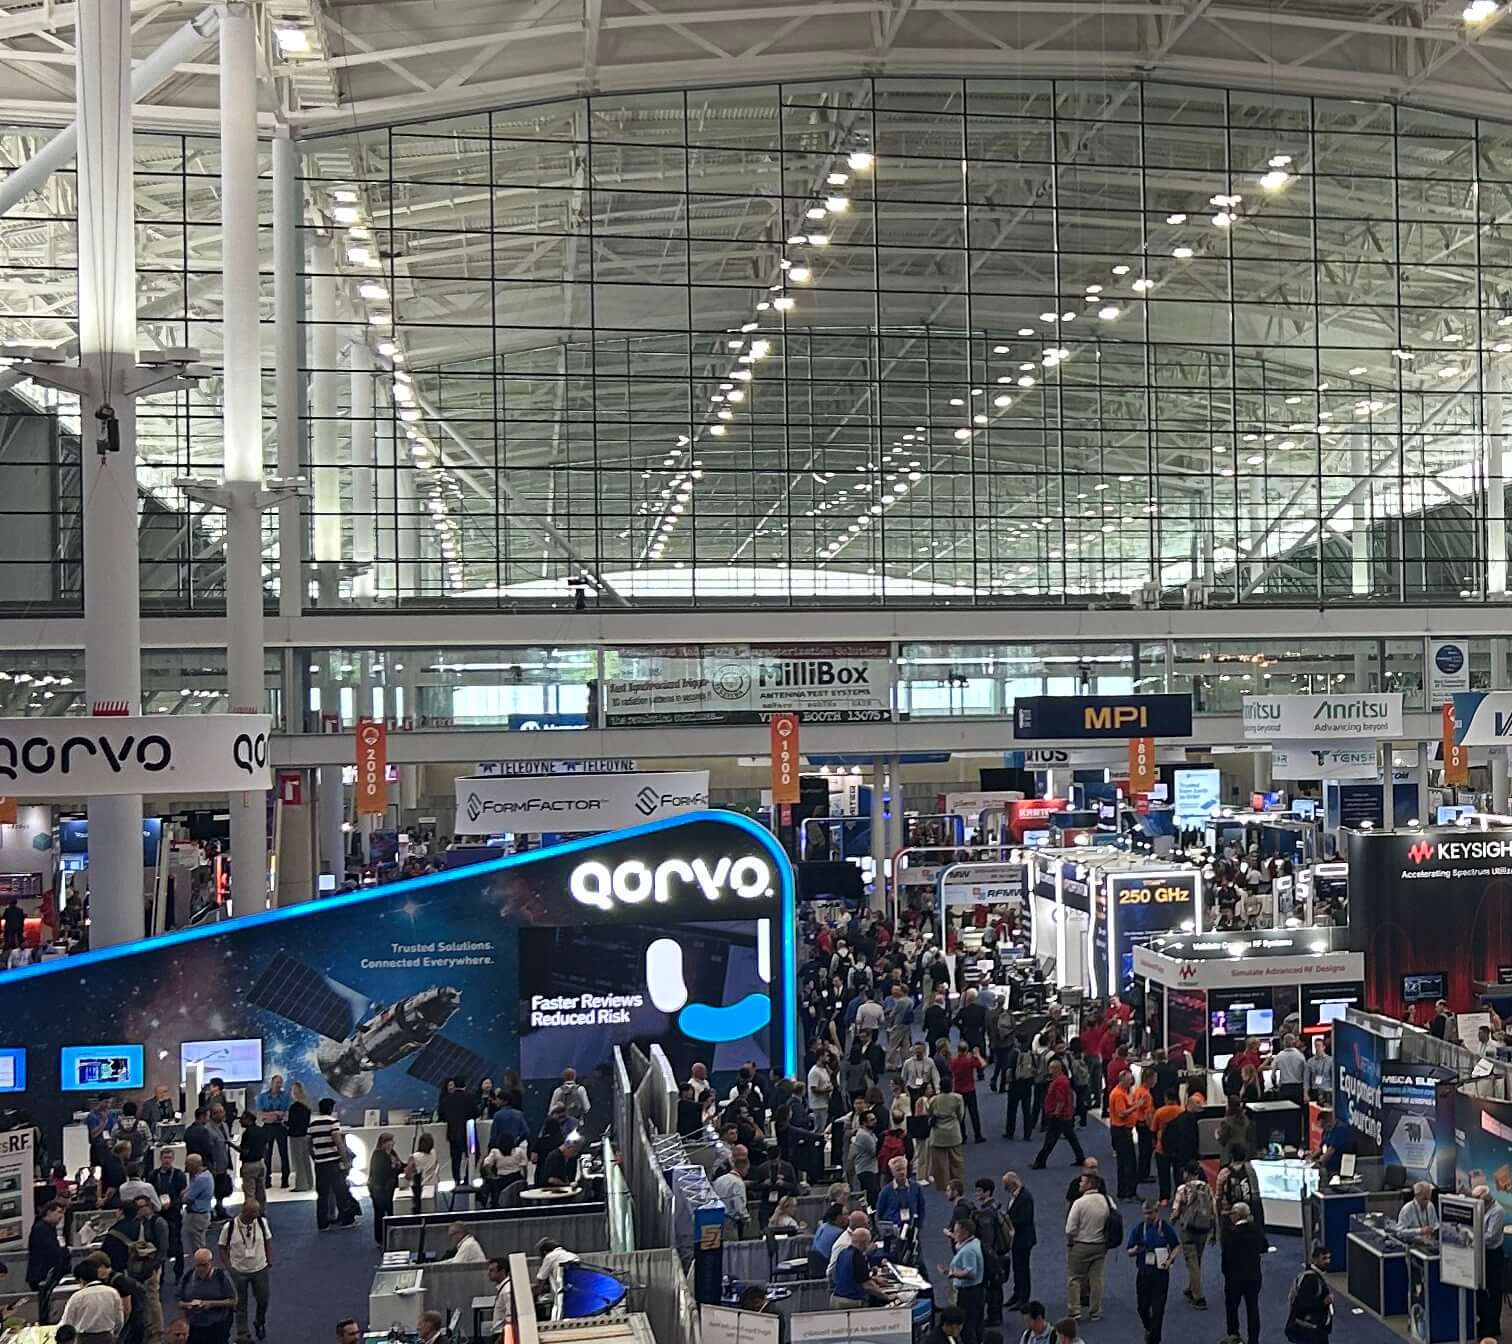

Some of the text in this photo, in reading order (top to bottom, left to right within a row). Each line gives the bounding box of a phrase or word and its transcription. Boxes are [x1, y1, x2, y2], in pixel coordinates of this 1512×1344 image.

[759, 661, 869, 686] MilliBox
[760, 688, 870, 700] ANTENNA TEST SYSTEMS
[803, 711, 841, 722] BOOTH
[847, 711, 881, 721] 13075
[1084, 705, 1148, 729] MPI
[1313, 700, 1388, 719] Anritsu
[1314, 722, 1361, 734] Advancing
[781, 740, 791, 784] 1900
[1138, 738, 1146, 775] 800
[366, 749, 377, 796] 2000
[1401, 868, 1451, 879] Accelerating
[1452, 867, 1490, 878] Spectrum
[1118, 886, 1190, 905] 250 GHz
[392, 940, 495, 954] Trusted Solutions.
[360, 956, 495, 970] Connected Everywhere.
[1231, 967, 1263, 977] Simulate
[1266, 966, 1302, 977] Advanced
[1315, 964, 1346, 975] Designs
[531, 992, 643, 1012] Faster Reviews
[531, 1008, 630, 1027] Reduced Risk
[1339, 1066, 1383, 1110] Equipment
[1382, 1074, 1413, 1085] MECA
[1348, 1101, 1383, 1147] Sourcing
